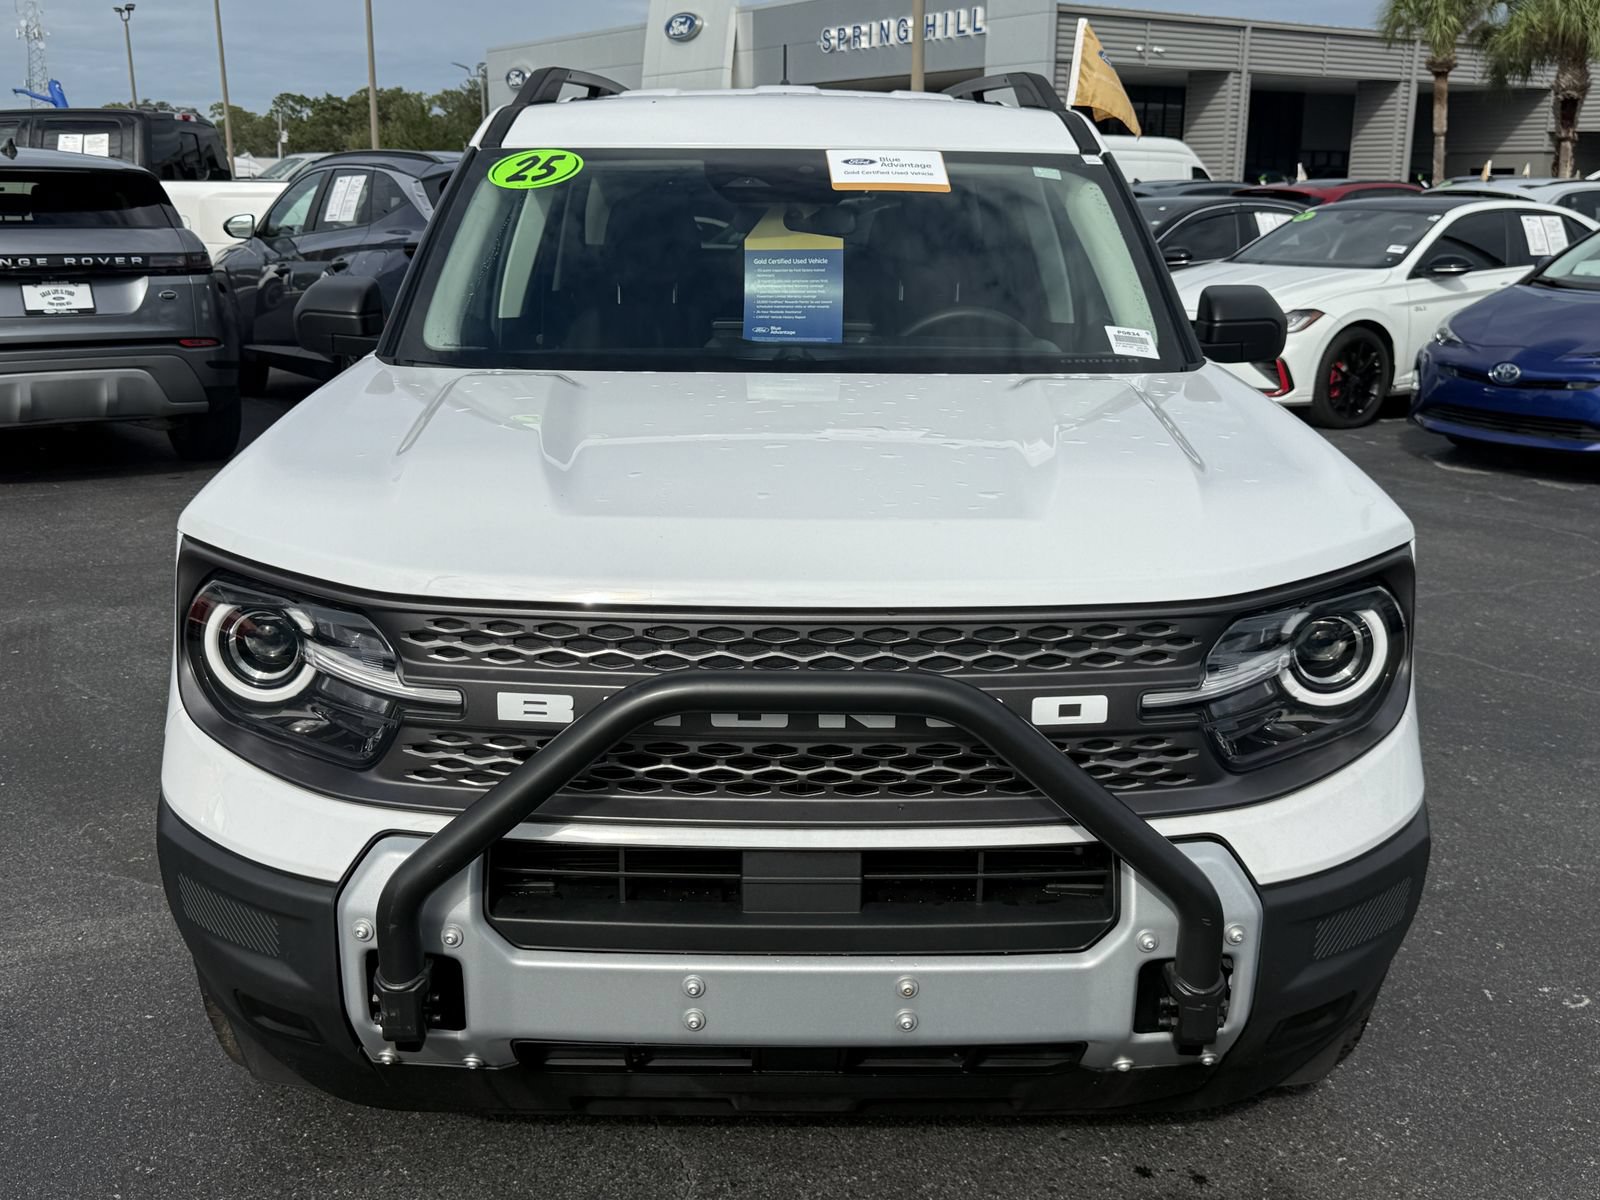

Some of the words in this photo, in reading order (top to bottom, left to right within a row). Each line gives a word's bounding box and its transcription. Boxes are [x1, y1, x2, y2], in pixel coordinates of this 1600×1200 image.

[667, 16, 694, 36] Ford
[821, 18, 912, 53] SPRING
[924, 7, 987, 40] HILL
[505, 155, 567, 182] 25
[63, 256, 143, 266] ROVER
